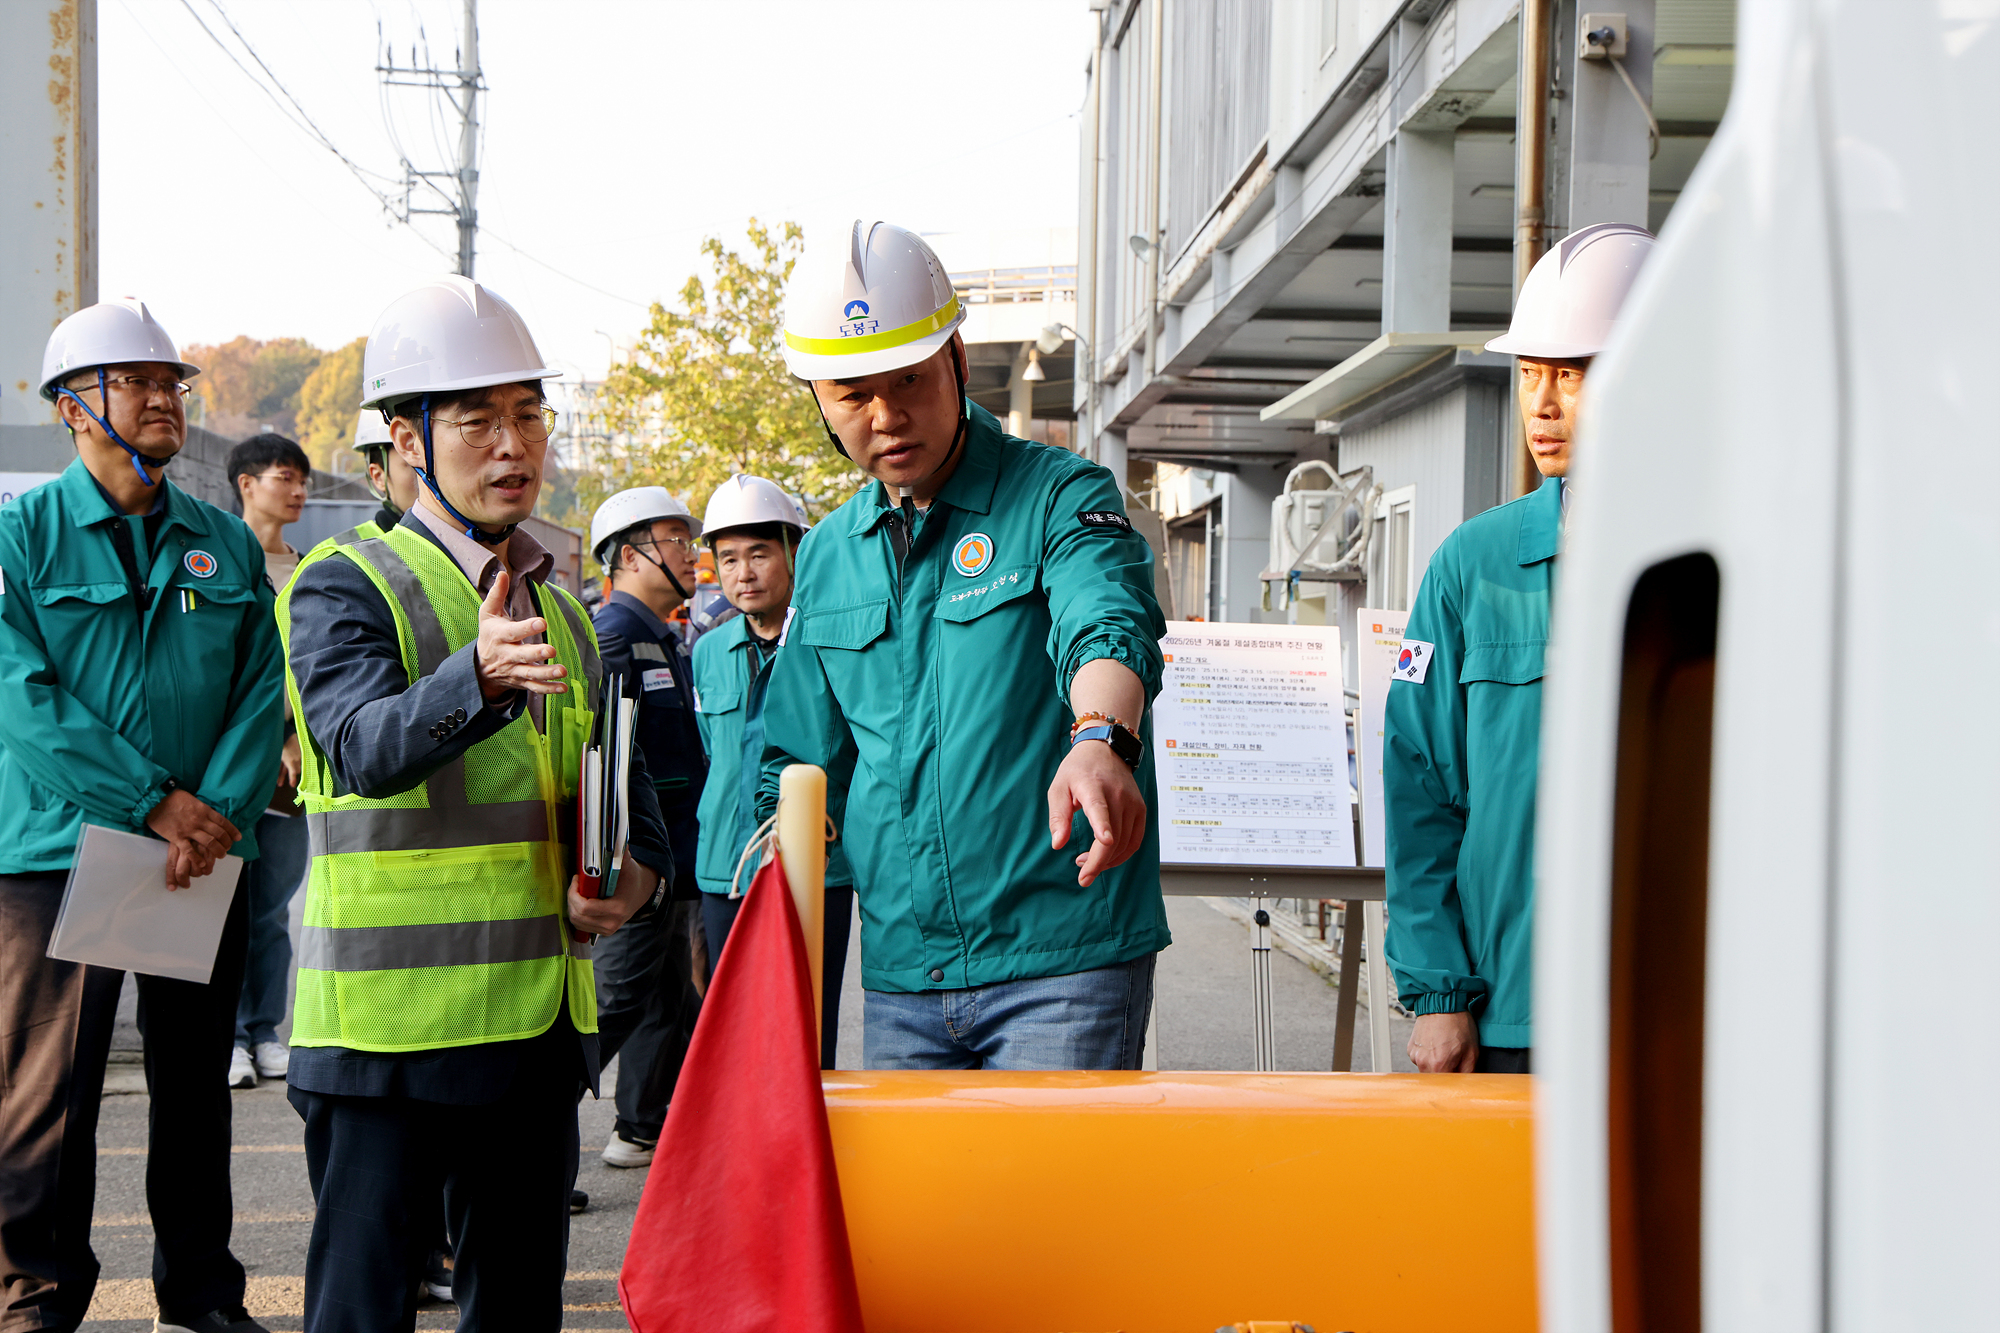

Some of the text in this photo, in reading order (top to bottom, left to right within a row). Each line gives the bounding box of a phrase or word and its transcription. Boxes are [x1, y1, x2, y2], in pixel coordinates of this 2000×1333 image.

[839, 320, 880, 338] 도봉구
[1085, 513, 1128, 526] 서울 도봉구
[1165, 637, 1323, 651] 2025/26년 겨울철 제설종합대책 추진 현황
